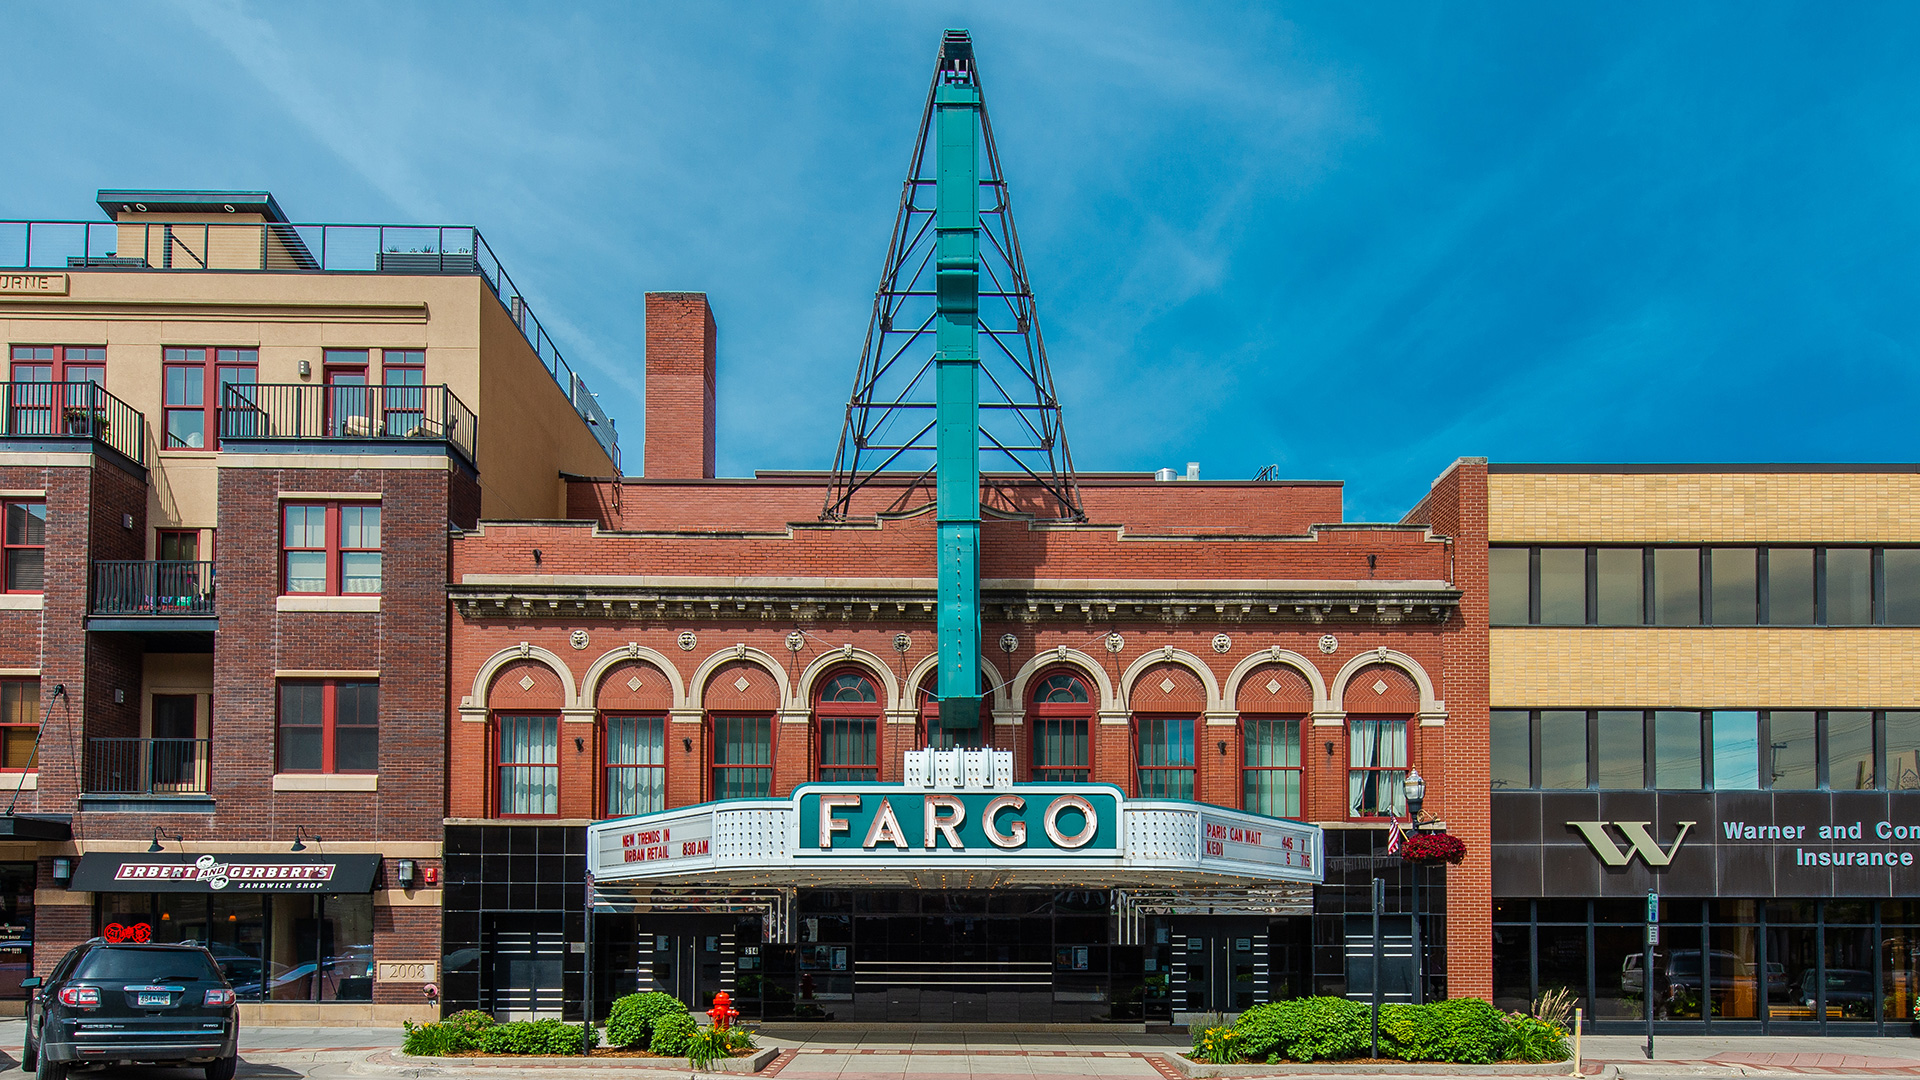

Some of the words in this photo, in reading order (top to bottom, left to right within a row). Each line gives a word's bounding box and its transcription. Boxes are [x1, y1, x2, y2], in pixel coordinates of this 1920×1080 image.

[819, 793, 1098, 848] FARGO
[622, 833, 635, 848] NEW
[637, 830, 660, 846] TRENDS
[663, 829, 670, 842] IN
[1206, 823, 1227, 840] PARIS
[1230, 827, 1243, 842] CAN
[1245, 830, 1262, 845] WAIT
[1282, 836, 1293, 850] 445
[1301, 839, 1305, 851] 7
[1723, 821, 1806, 839] Warner
[1819, 821, 1862, 840] and
[1566, 821, 1697, 866] W
[624, 848, 645, 863] URBAN
[647, 845, 669, 860] RETAIL
[1206, 840, 1224, 856] KEDI
[1286, 853, 1290, 864] 5
[1301, 854, 1310, 868] 715
[1797, 848, 1914, 867] Insurance
[121, 866, 196, 878] ERBERT
[200, 866, 225, 877] AND
[229, 866, 329, 878] GERBERT'S
[389, 963, 425, 978] 2008
